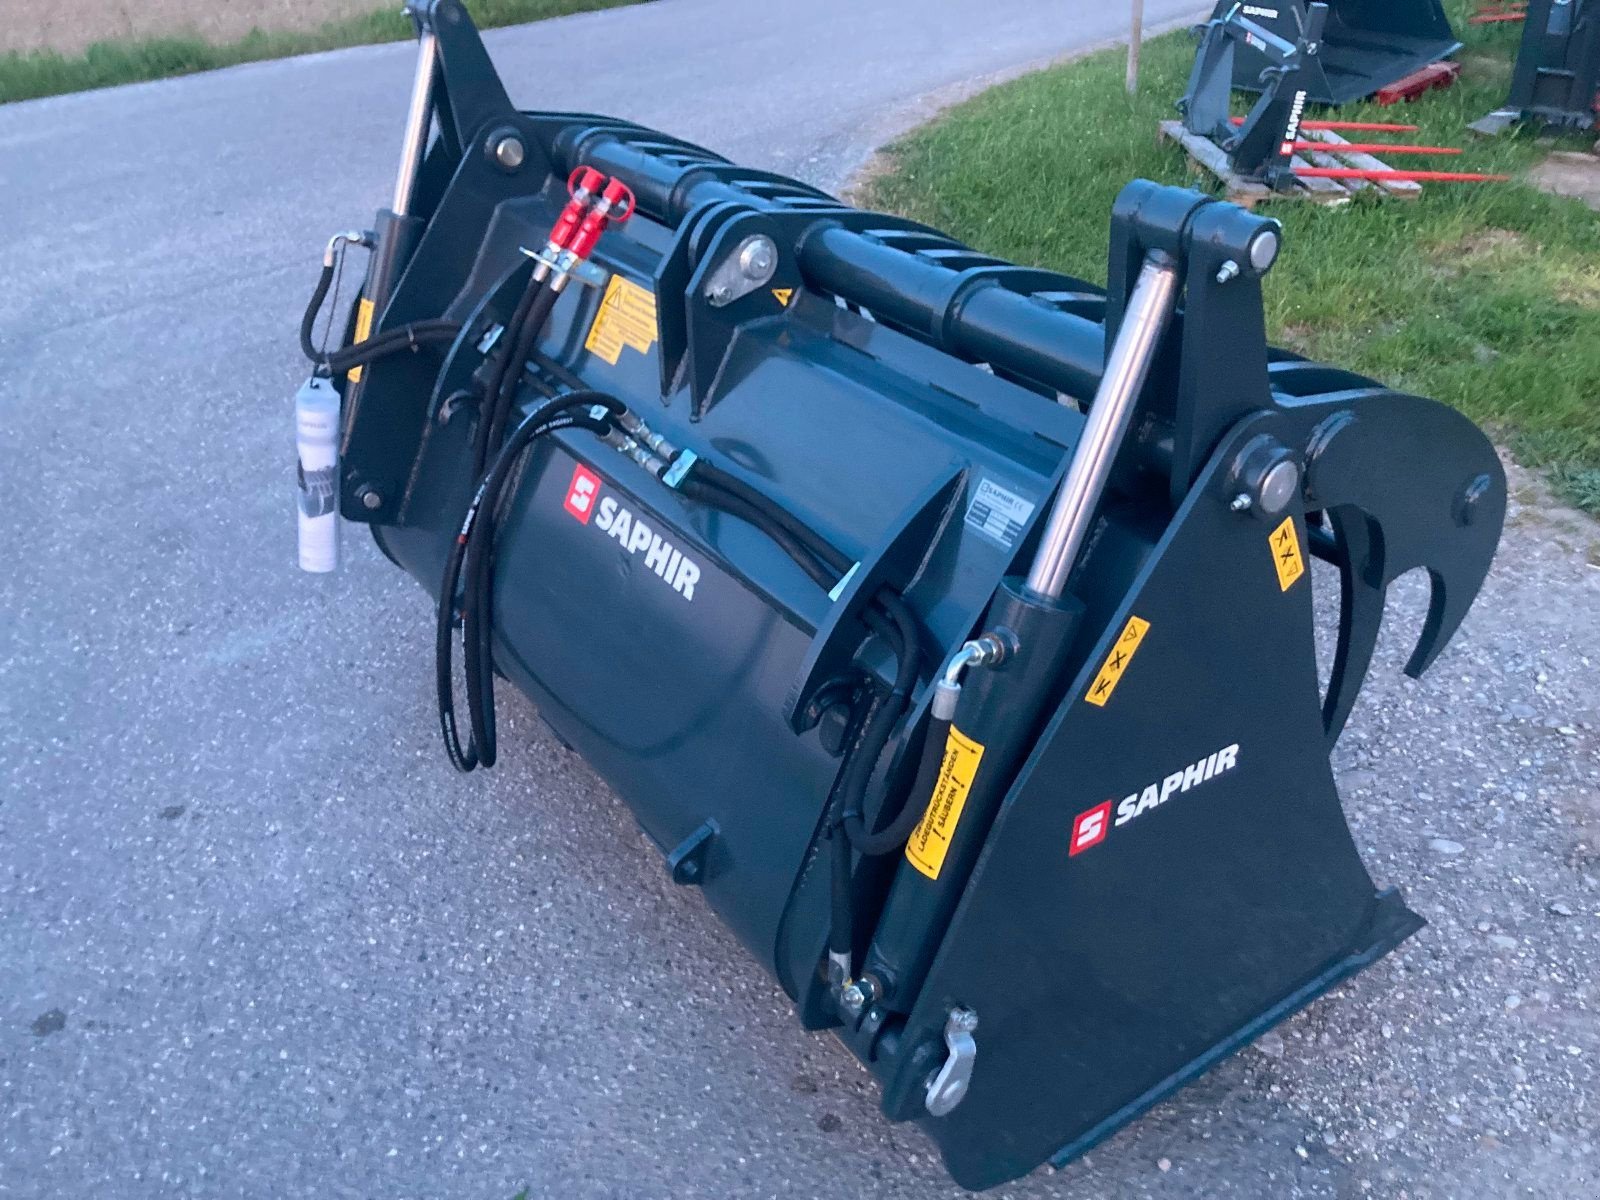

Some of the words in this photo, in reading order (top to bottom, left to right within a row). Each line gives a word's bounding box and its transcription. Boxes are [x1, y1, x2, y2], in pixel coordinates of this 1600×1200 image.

[1285, 90, 1307, 140] SAPHIR
[595, 496, 700, 601] SAPHIR
[937, 786, 958, 828] SÄUBERN
[1114, 743, 1240, 826] SAPHIR
